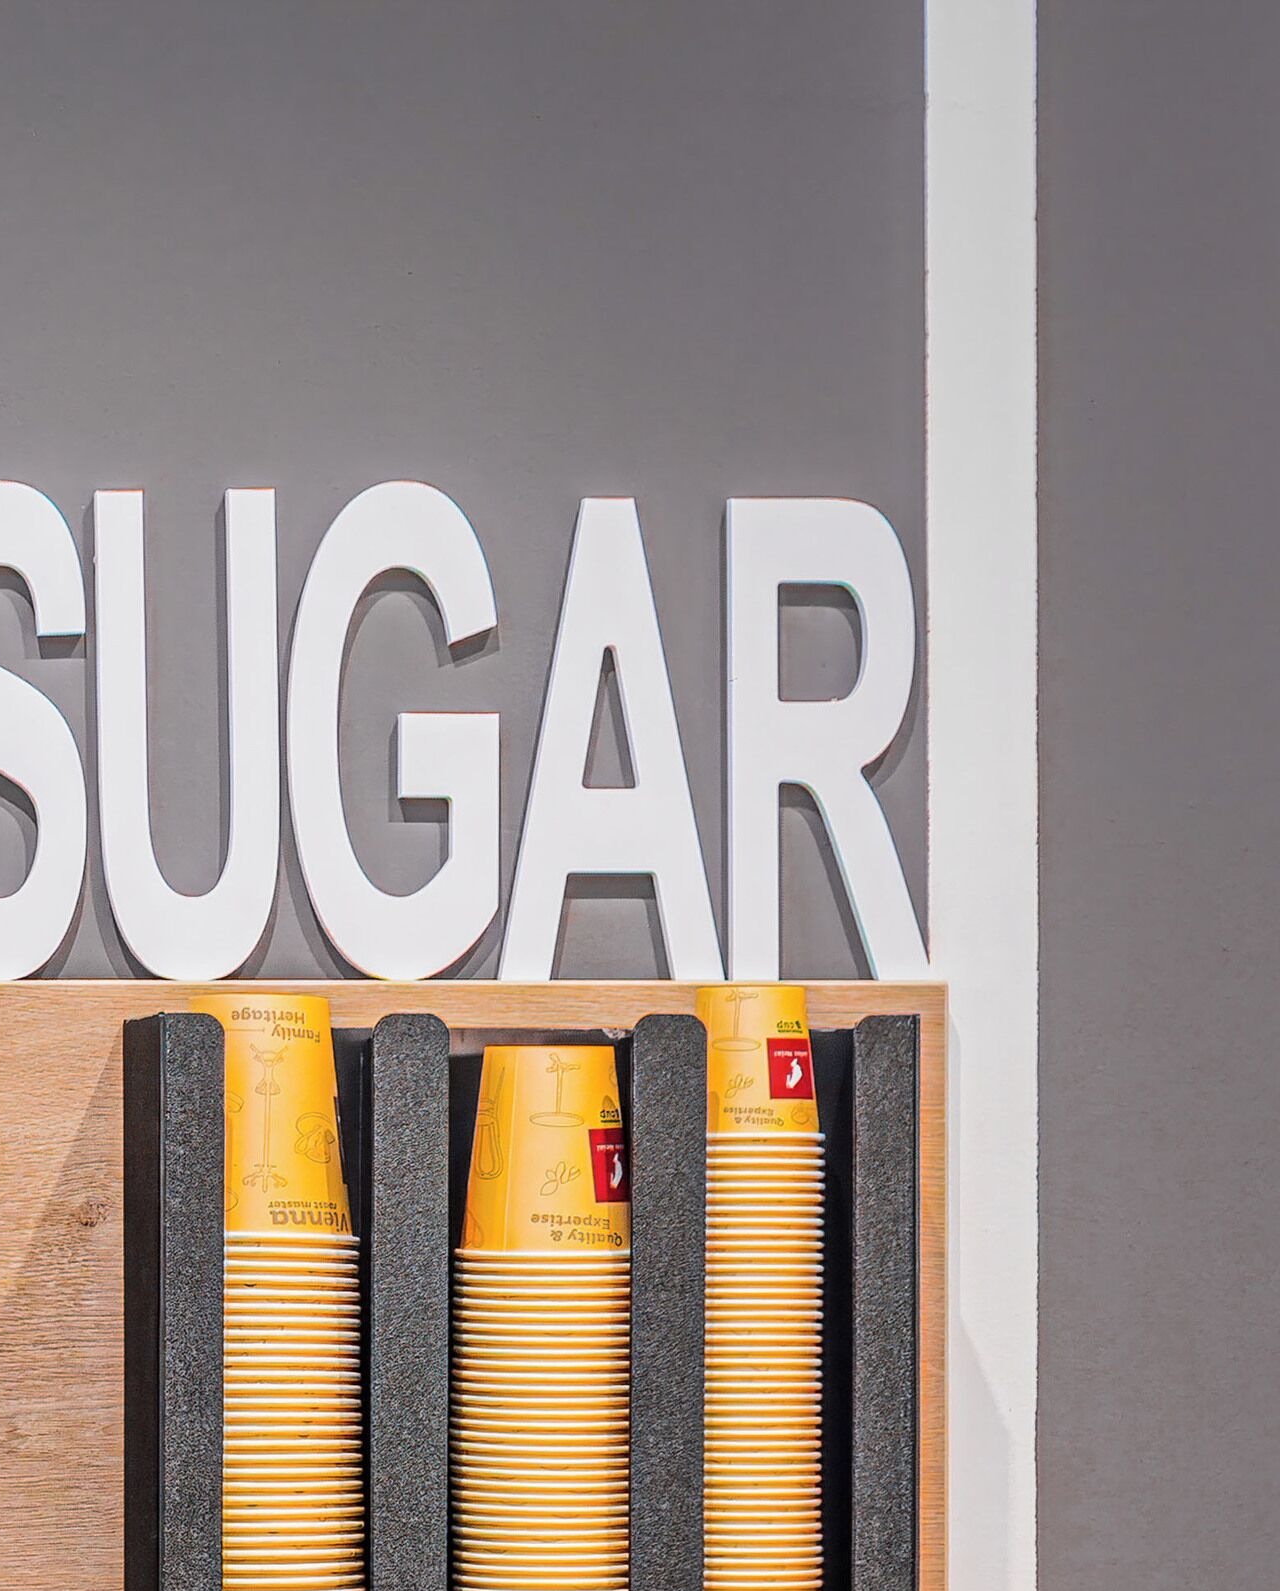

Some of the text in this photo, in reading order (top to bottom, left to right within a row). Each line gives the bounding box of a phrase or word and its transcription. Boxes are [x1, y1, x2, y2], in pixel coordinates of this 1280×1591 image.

[231, 1008, 305, 1025] Heritage
[271, 1027, 320, 1044] Family
[269, 1210, 348, 1232] Vienna
[531, 1213, 610, 1229] Expertise
[550, 1229, 622, 1247] Quality &
